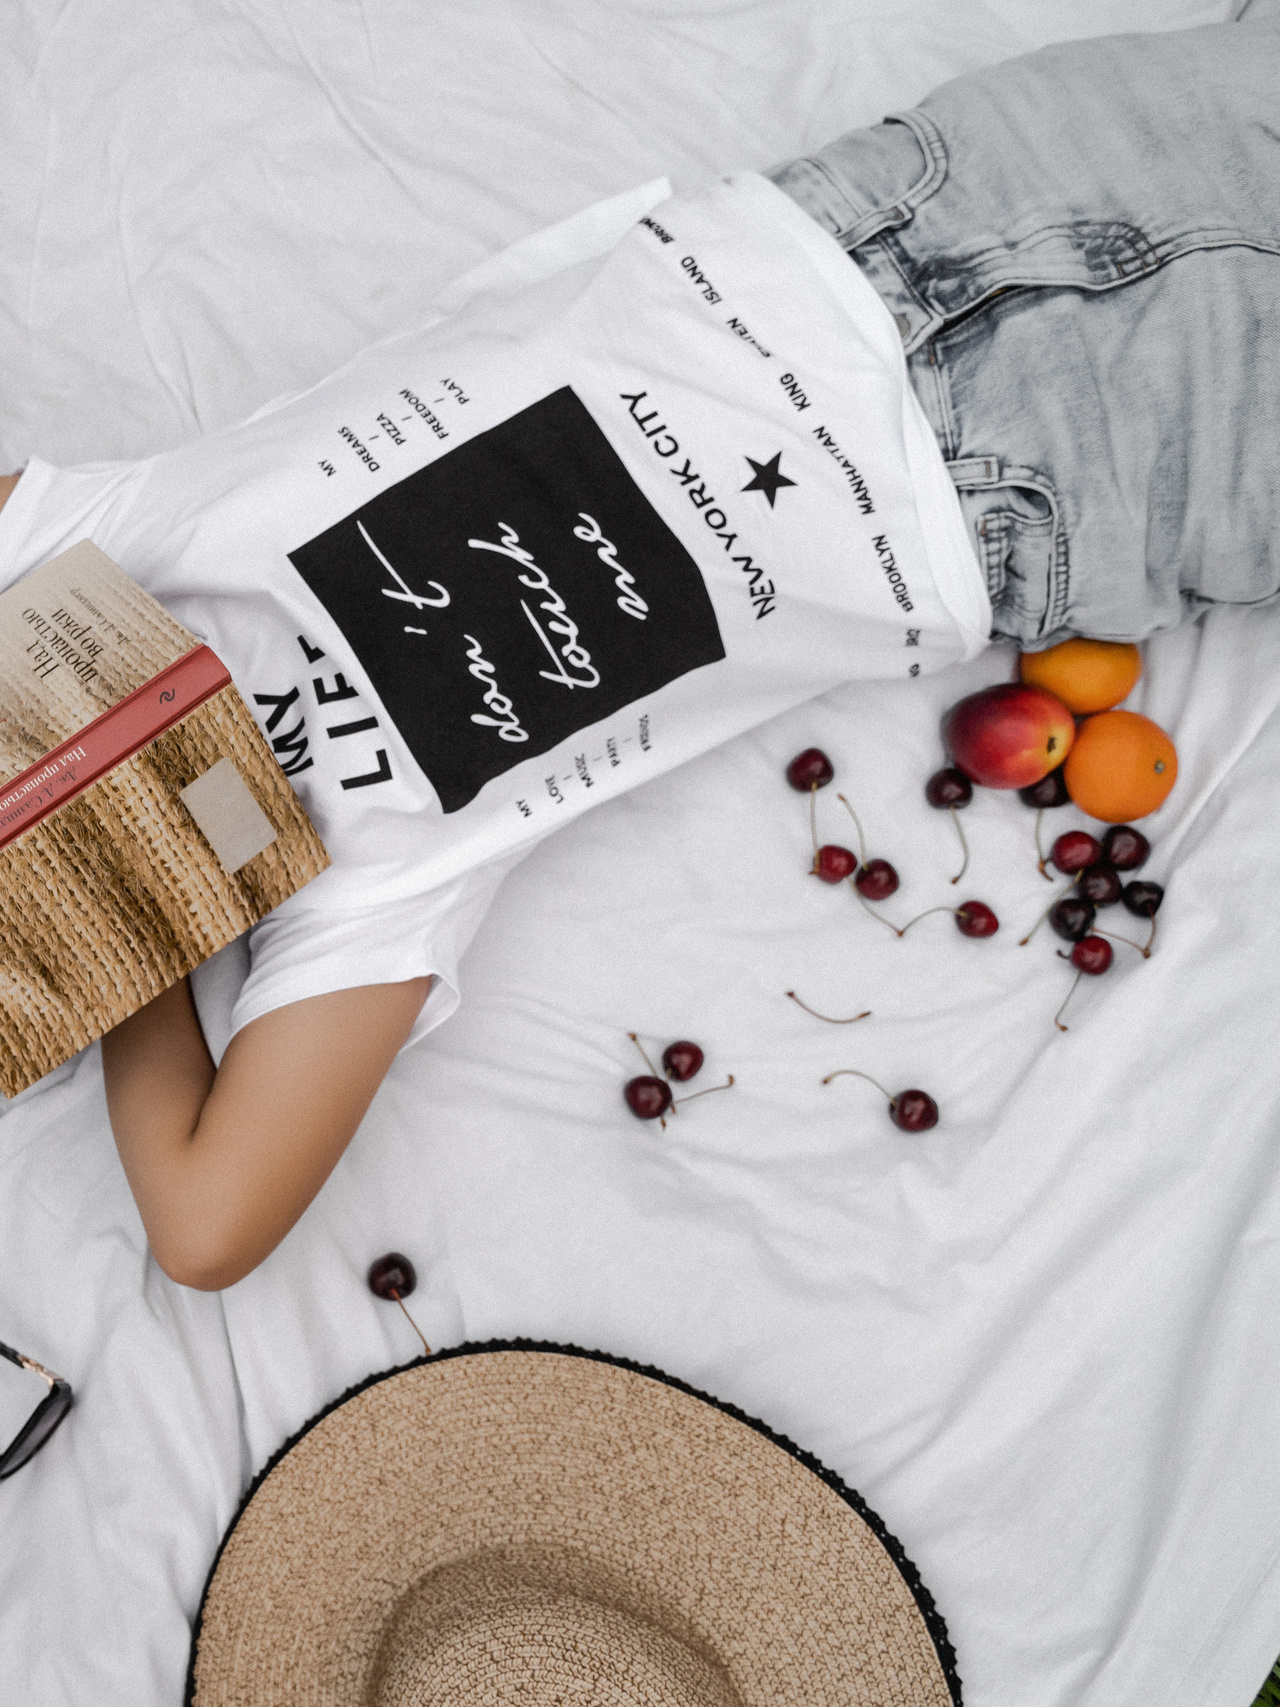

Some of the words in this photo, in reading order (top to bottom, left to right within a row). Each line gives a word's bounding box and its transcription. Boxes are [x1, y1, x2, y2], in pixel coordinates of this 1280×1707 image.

[680, 255, 722, 305] ISLAND
[398, 388, 450, 440] FREEDOM
[441, 377, 470, 405] PLAY
[779, 372, 811, 412] KING
[337, 426, 380, 473] DREAMS
[376, 412, 407, 446] PIZZA
[620, 391, 678, 457] CITY
[318, 459, 336, 477] MY
[812, 425, 876, 516] MANHATTAN
[670, 458, 737, 551] YORK
[574, 513, 648, 620] me
[731, 556, 776, 620] NEW
[871, 534, 914, 613] BROOKLYN
[52, 608, 91, 640] ржи
[357, 521, 529, 742] don't
[468, 522, 600, 690] touch
[23, 608, 98, 683] пропастью
[24, 640, 58, 680] Над
[79, 636, 103, 658] во
[58, 746, 86, 764] Над
[253, 685, 314, 782] MY
[516, 799, 532, 818] MY
